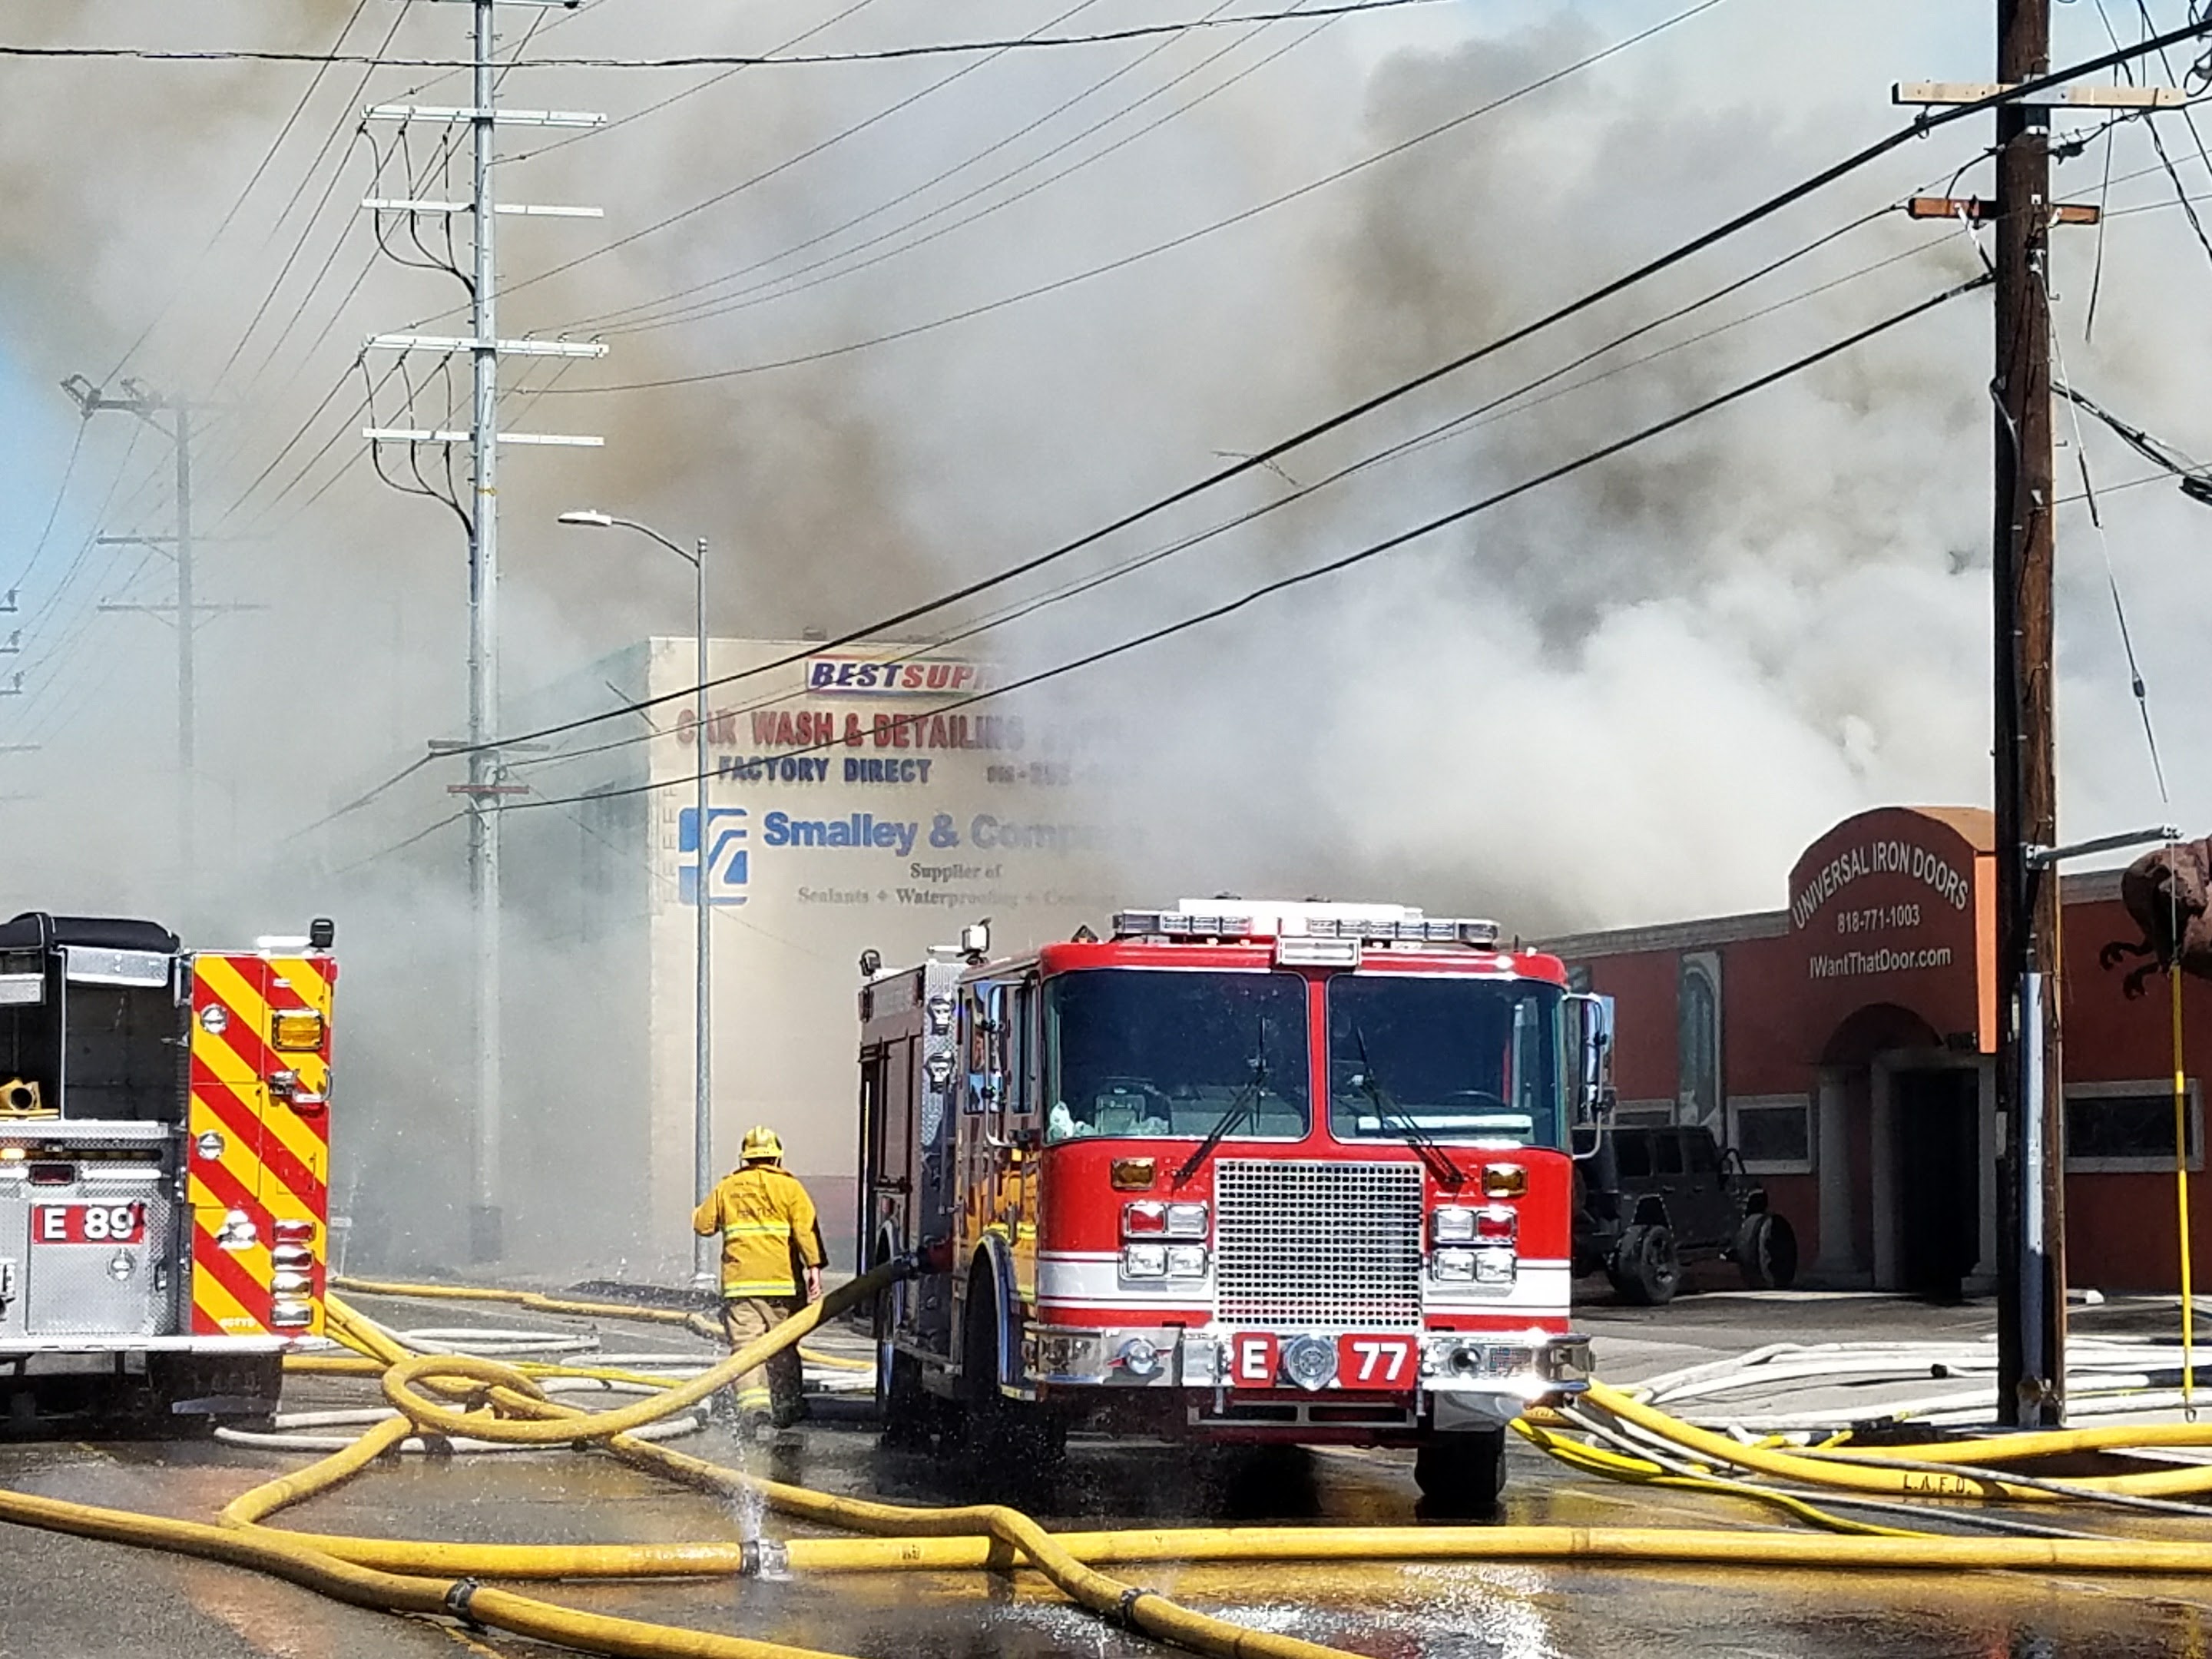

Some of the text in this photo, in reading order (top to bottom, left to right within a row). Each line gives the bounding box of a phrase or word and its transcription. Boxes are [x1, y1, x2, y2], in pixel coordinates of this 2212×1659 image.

[751, 710, 834, 746] WASH
[845, 713, 863, 747] &
[718, 757, 932, 784] FACTORY DIRECT
[763, 811, 919, 857] Smalley
[929, 813, 959, 848] &
[909, 862, 1003, 882] Supplier of
[1791, 841, 1969, 930] UNIVERSAL IRON DOORS
[798, 886, 869, 905] Sealants
[1836, 904, 1920, 934] 818-771-1003
[1810, 947, 1952, 979] IWantThatDoor.com
[44, 1207, 134, 1240] E 89
[1242, 1340, 1408, 1381] E 77
